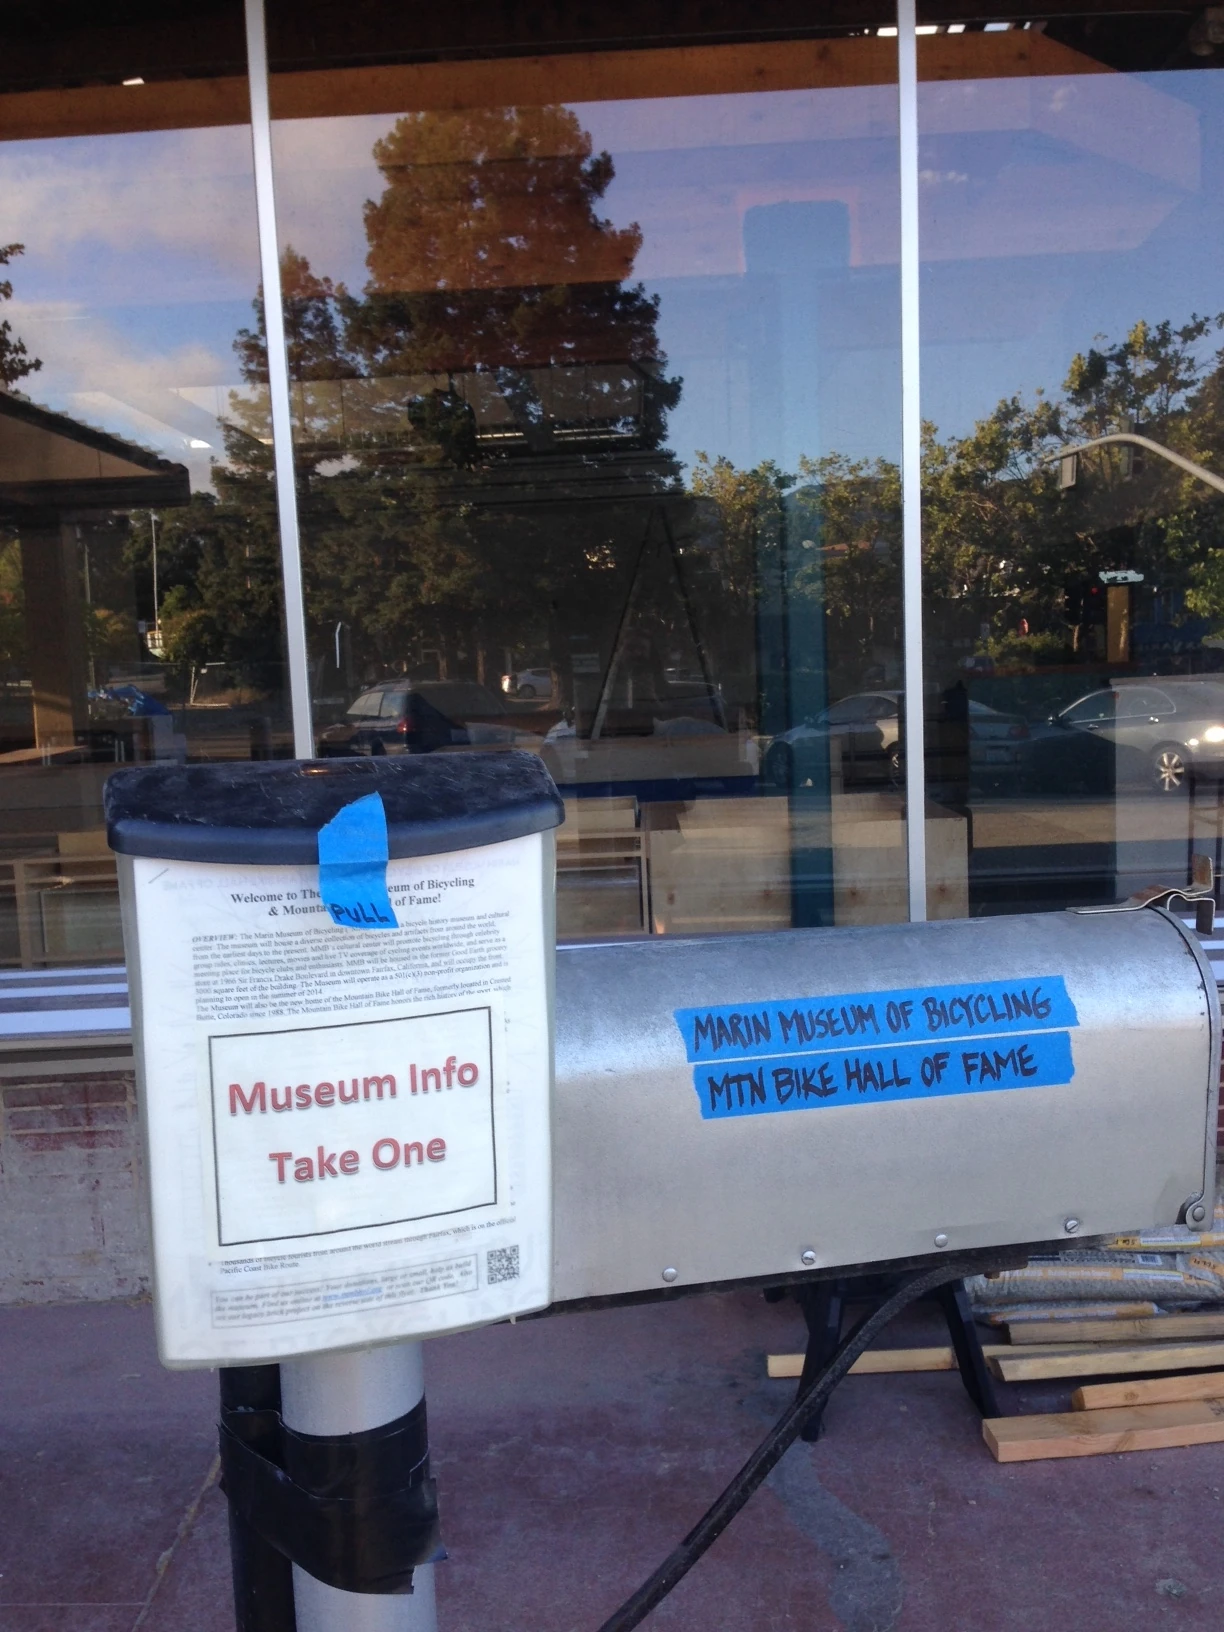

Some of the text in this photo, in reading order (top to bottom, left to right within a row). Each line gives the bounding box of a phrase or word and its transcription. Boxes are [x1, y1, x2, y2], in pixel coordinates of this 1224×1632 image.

[230, 892, 283, 904] Welcome
[286, 891, 298, 900] to
[300, 889, 321, 900] The
[414, 880, 426, 891] of
[428, 876, 476, 890] Bicycling
[268, 907, 279, 916] &
[282, 903, 328, 916] Mounta
[395, 896, 408, 906] of
[408, 893, 442, 905] Fame!
[330, 902, 390, 923] PULL
[313, 926, 343, 936] Bicycling
[251, 965, 276, 976] bicycle
[276, 964, 295, 972] clubs
[345, 958, 366, 967] MMB
[451, 947, 468, 956] Good
[213, 987, 235, 996] square
[356, 974, 380, 985] operate
[423, 965, 454, 976] non-profit
[454, 962, 491, 974] organization
[274, 973, 294, 982] Drake
[295, 970, 329, 980] Boulevard
[337, 969, 370, 977] downtown
[233, 995, 250, 1004] open
[343, 993, 374, 1001] Mountain
[374, 990, 390, 998] Bike
[390, 988, 405, 997] Hall
[217, 1010, 248, 1020] Colorado
[301, 1005, 332, 1014] Mountain
[332, 1002, 348, 1011] Bike
[348, 1001, 363, 1009] Hall
[694, 986, 1053, 1054] MARIN MUSEUM OF BICYCLING
[228, 1056, 480, 1116] Museum Info
[708, 1044, 1038, 1112] MTN BIKE HALL OF FAME
[268, 1137, 448, 1184] Take One
[220, 1266, 242, 1274] Pacific
